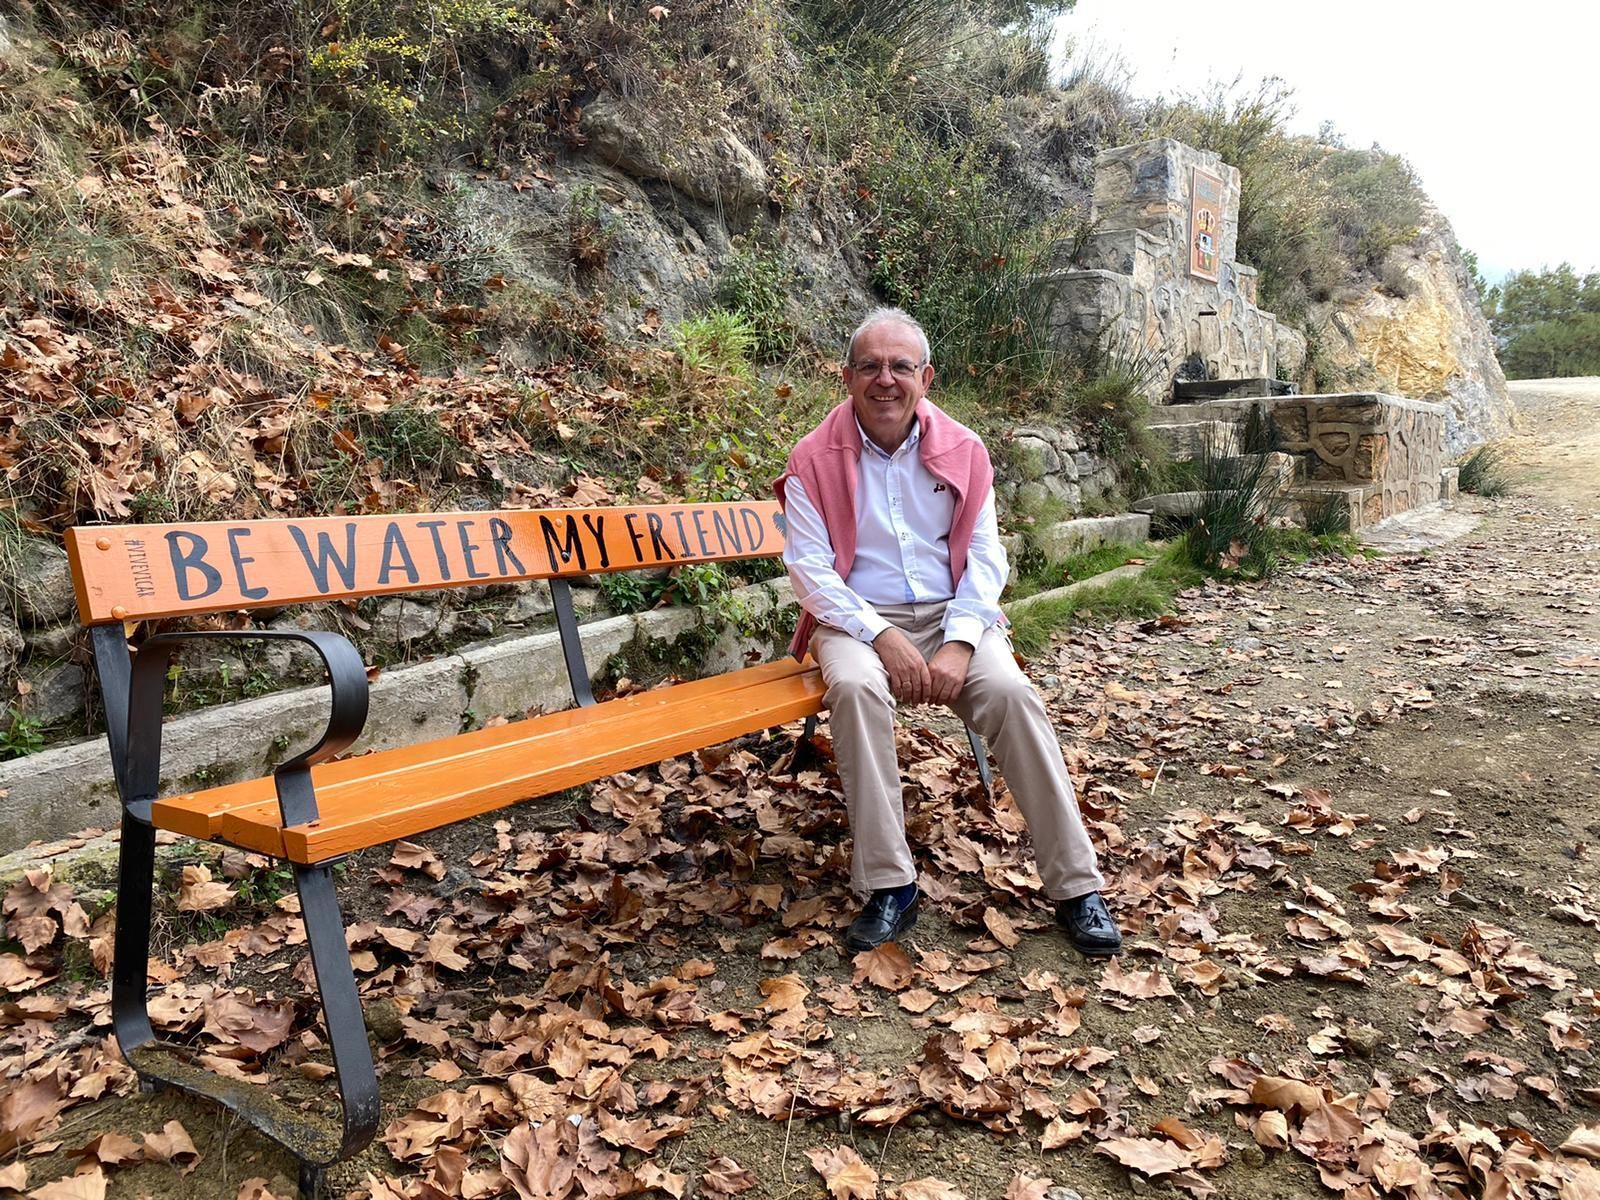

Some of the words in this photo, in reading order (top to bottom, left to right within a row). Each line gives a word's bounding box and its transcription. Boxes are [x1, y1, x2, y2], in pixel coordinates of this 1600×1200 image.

[163, 528, 269, 600] BE
[287, 517, 526, 597] WATER
[540, 514, 609, 573] MY
[624, 507, 764, 562] FRIEND
